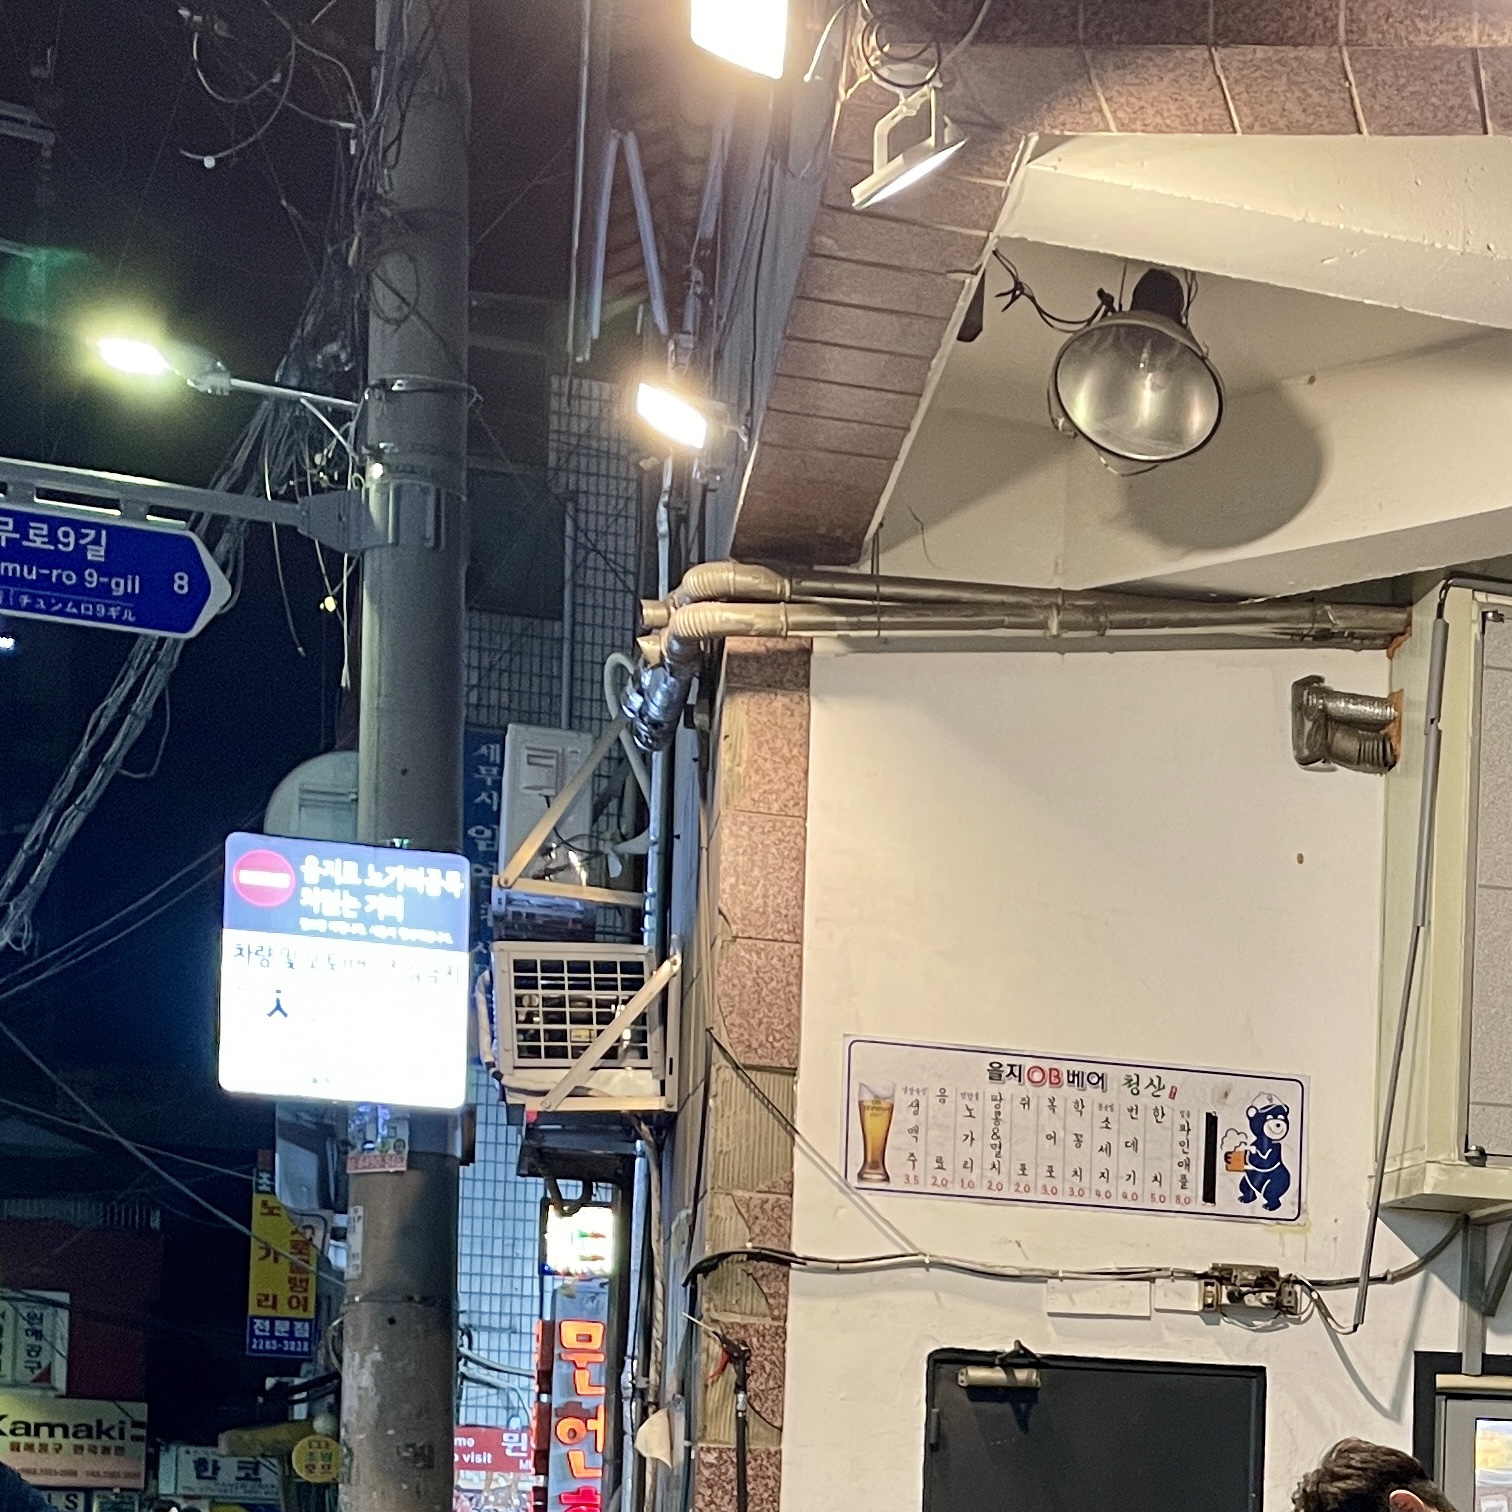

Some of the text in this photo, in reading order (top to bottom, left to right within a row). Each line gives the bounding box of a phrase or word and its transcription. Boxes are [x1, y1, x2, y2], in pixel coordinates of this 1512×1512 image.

[84, 568, 140, 596] 9-gil
[173, 571, 189, 595] 8
[962, 1103, 976, 1174] 노가리
[462, 1451, 493, 1464] visit
